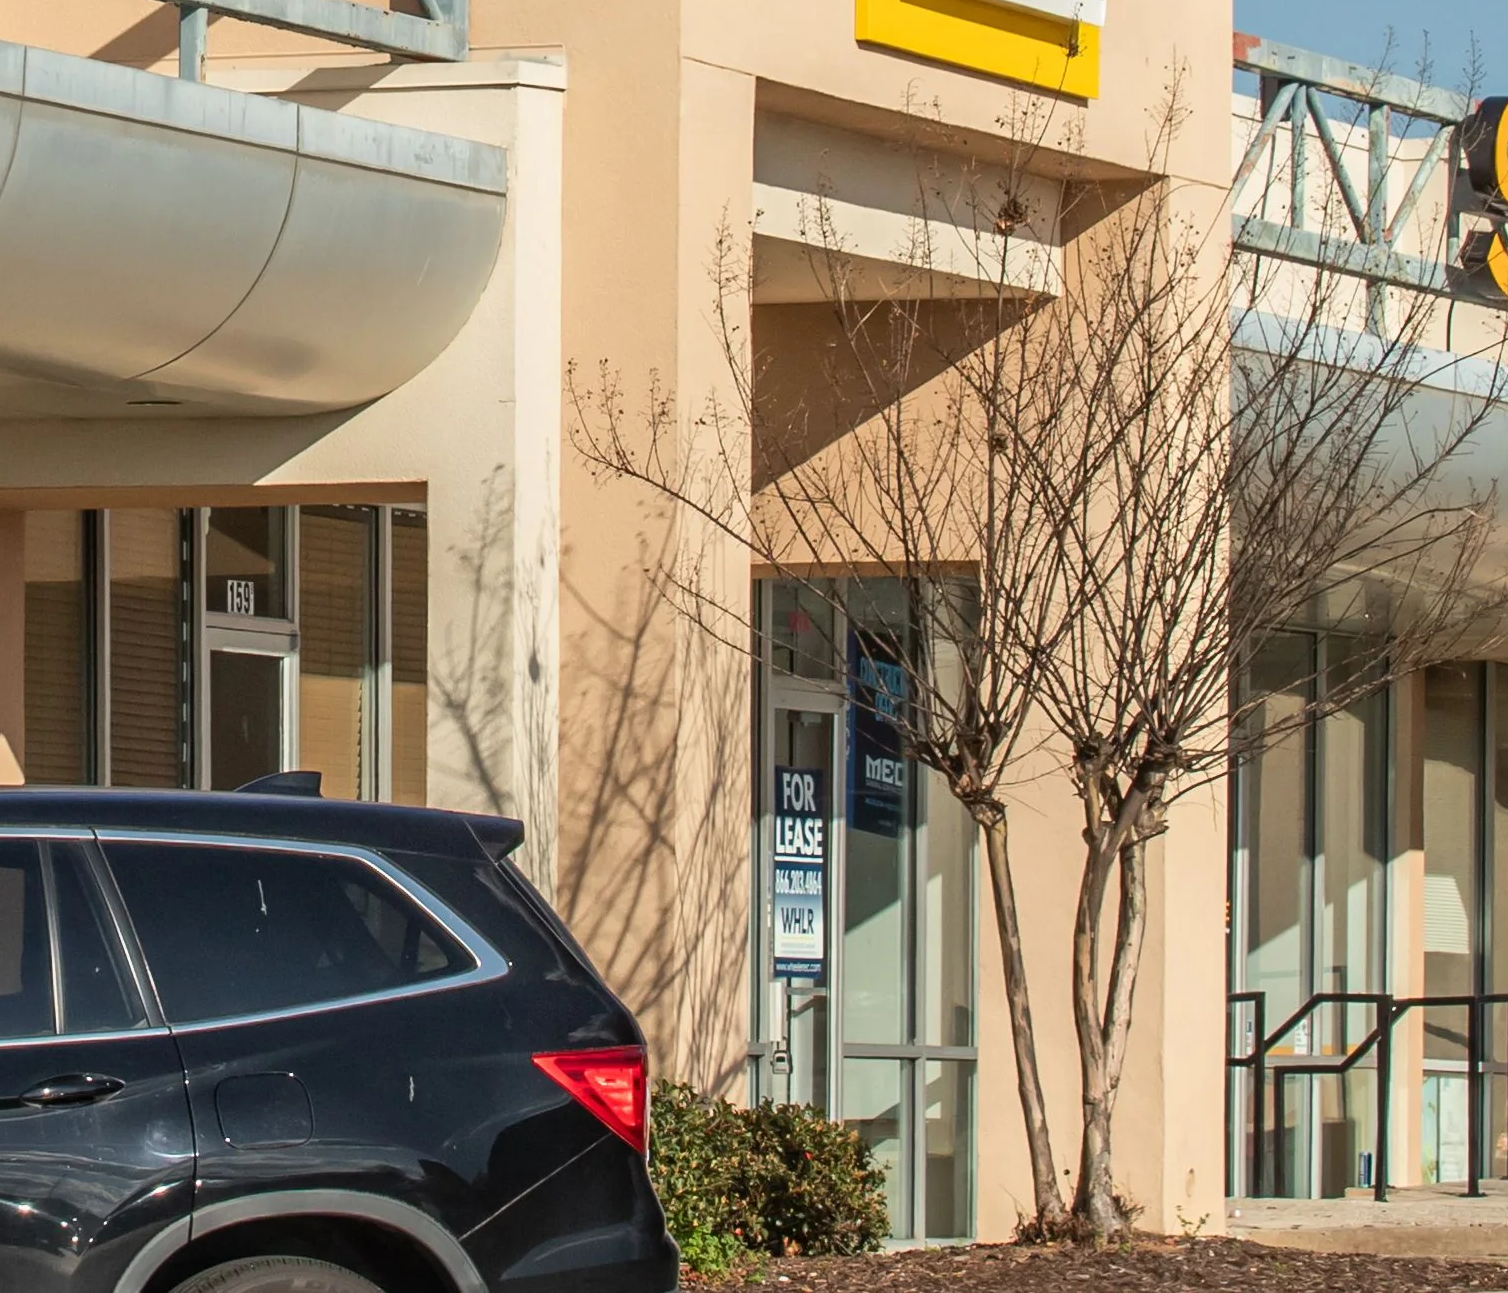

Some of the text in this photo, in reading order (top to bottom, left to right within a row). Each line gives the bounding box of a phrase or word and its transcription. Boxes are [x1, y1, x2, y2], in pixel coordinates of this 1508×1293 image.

[229, 581, 251, 614] 159
[782, 772, 816, 812] FOR
[775, 815, 823, 856] LEASE
[781, 907, 815, 934] WHLR
